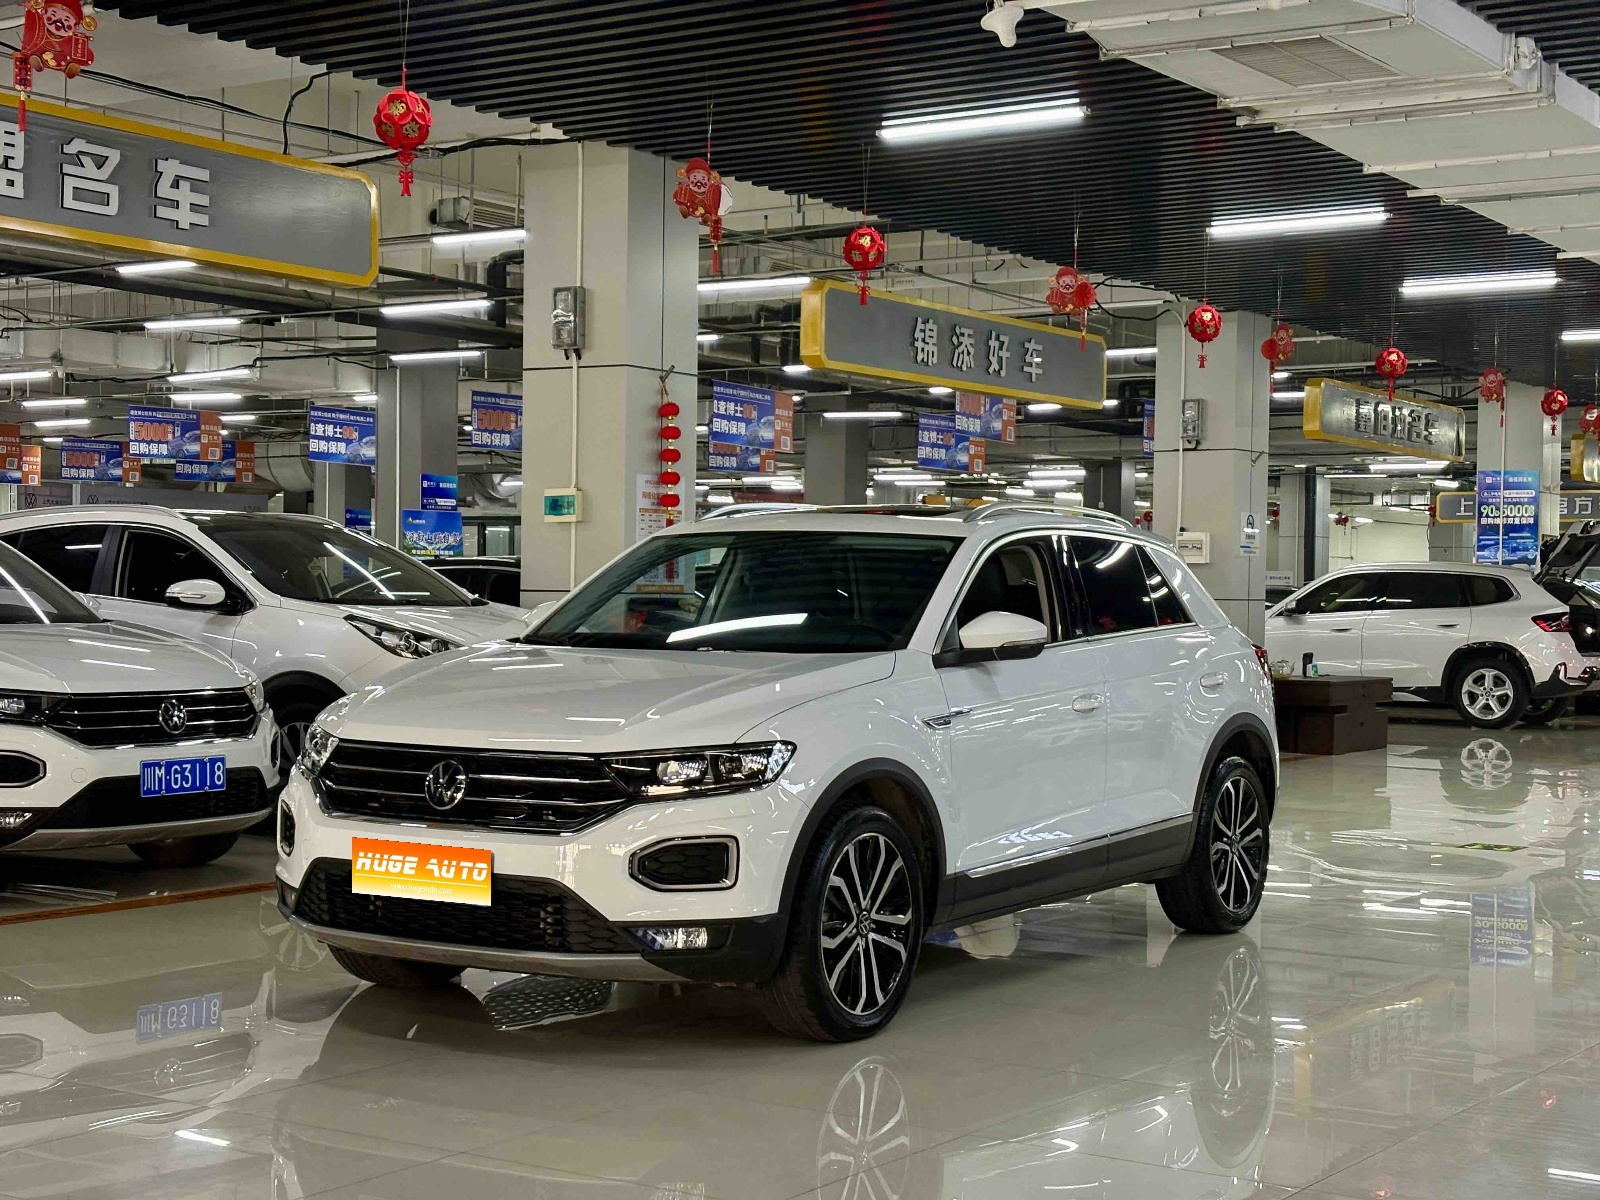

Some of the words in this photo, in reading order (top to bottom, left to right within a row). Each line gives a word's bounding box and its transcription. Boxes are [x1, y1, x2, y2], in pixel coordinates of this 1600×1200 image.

[913, 316, 1043, 383] 锦添好车
[478, 408, 511, 431] 5000
[713, 418, 746, 435] 回购保障
[956, 415, 981, 432] 回购保障
[135, 422, 168, 441] 5000
[316, 423, 343, 438] 查博士
[472, 431, 511, 446] 回购保障
[129, 442, 168, 455] 回购保障
[309, 439, 347, 454] 回购保障
[918, 446, 946, 460] 回购保障
[176, 463, 208, 474] 回购保障
[709, 456, 737, 467] 回购保障
[62, 467, 95, 478] 回购保障
